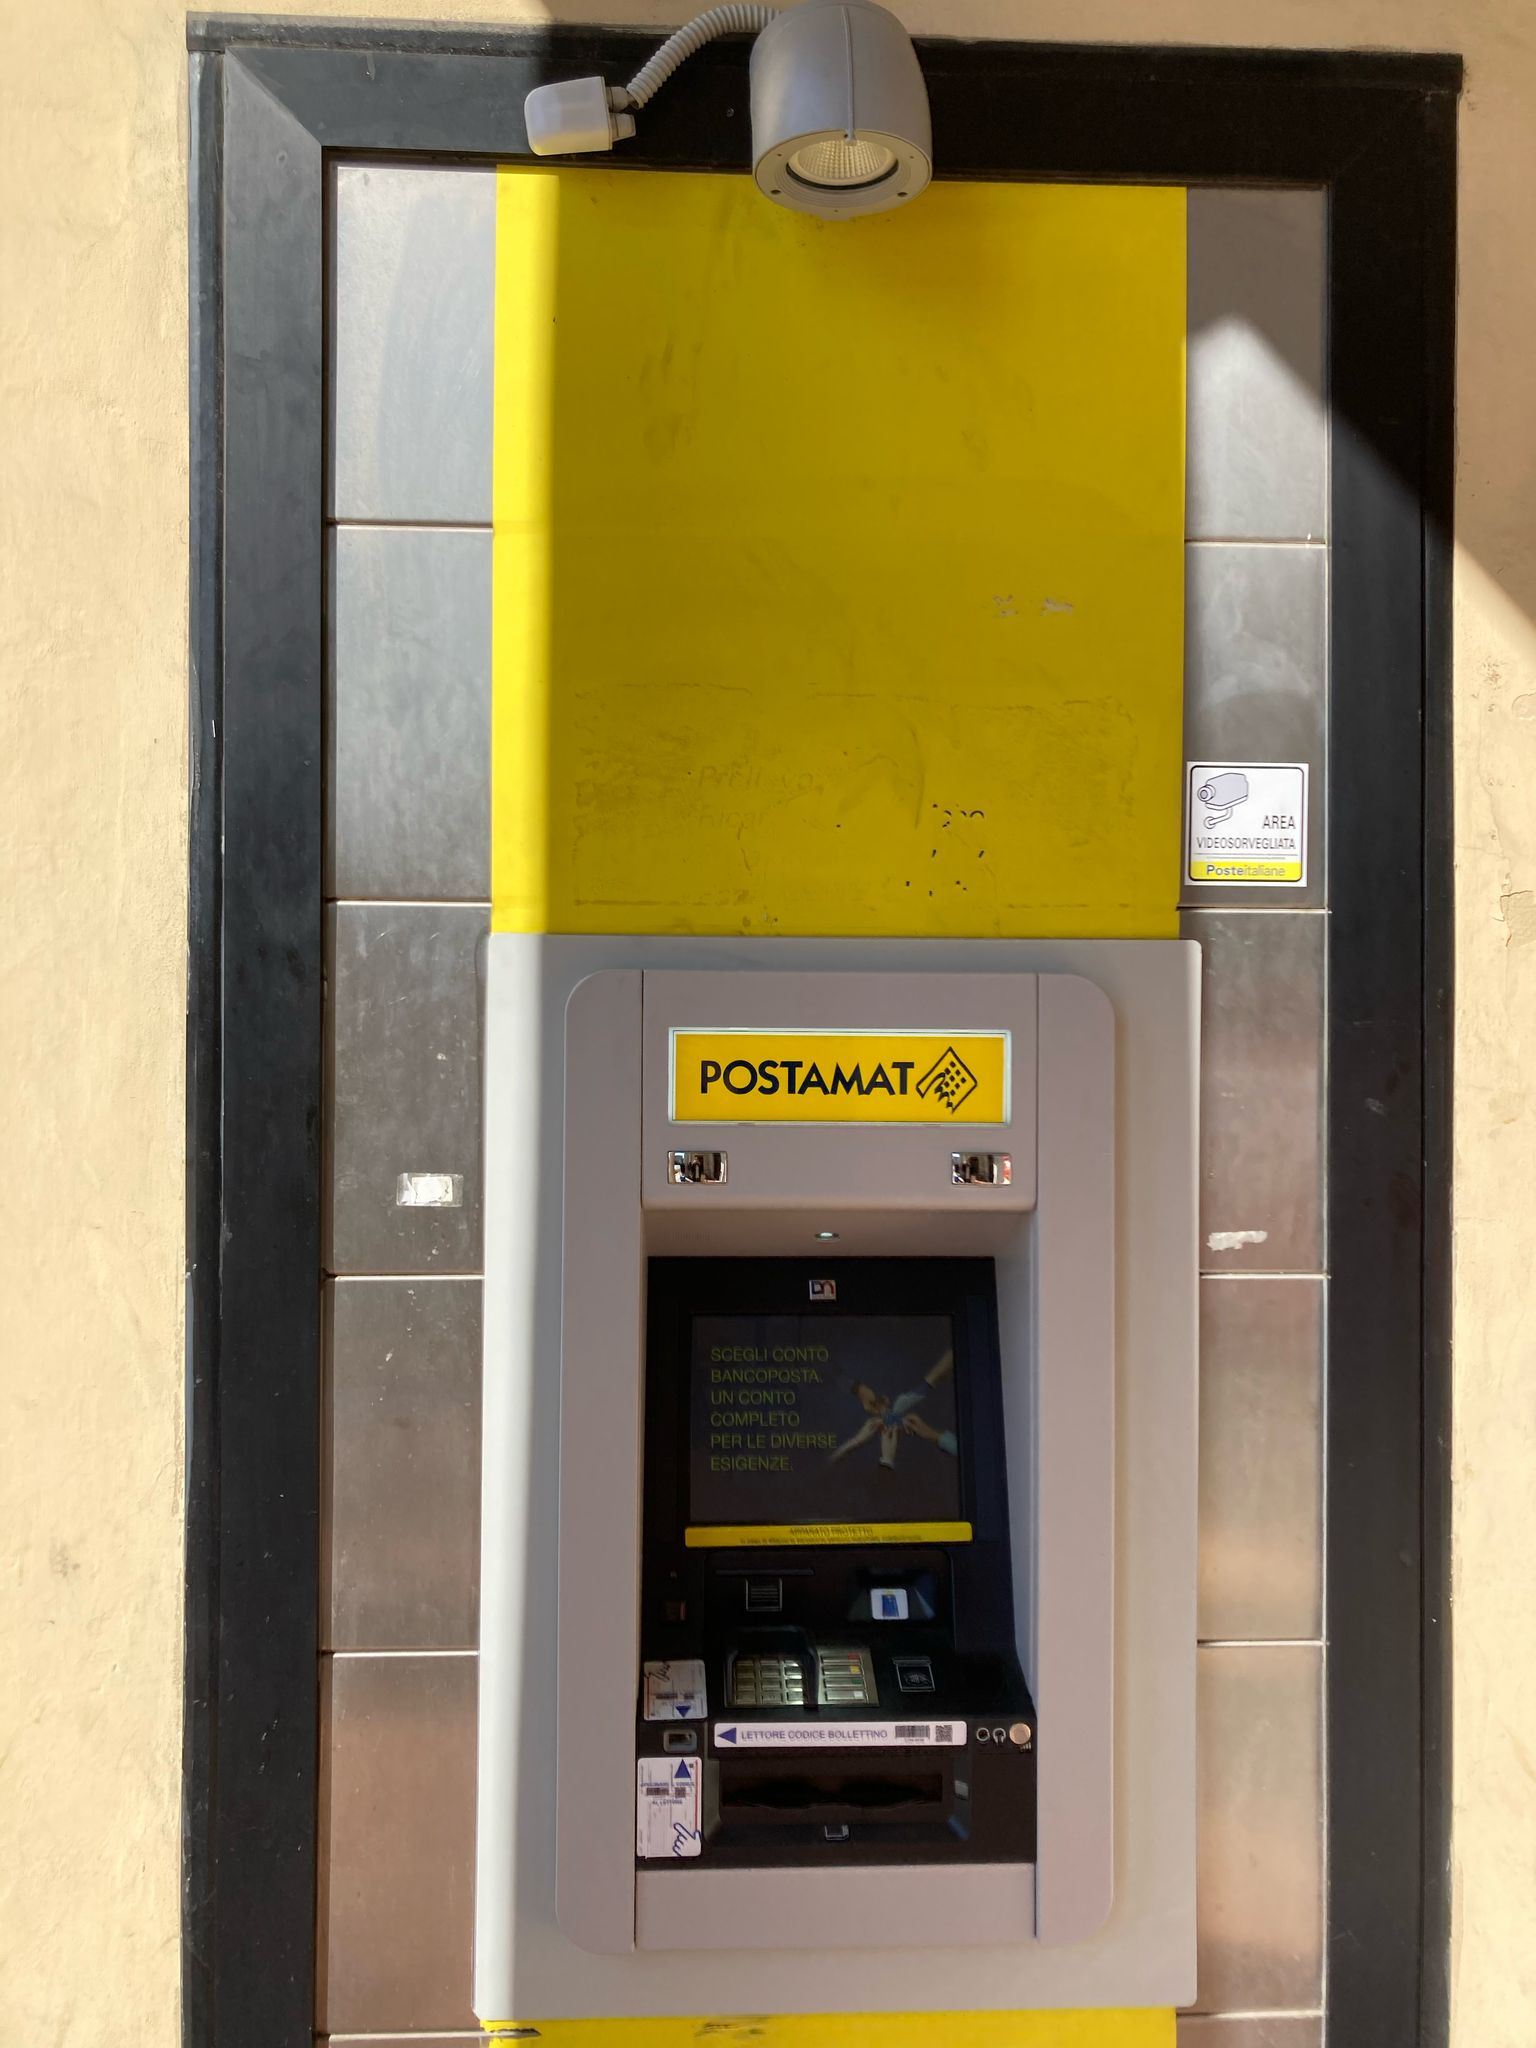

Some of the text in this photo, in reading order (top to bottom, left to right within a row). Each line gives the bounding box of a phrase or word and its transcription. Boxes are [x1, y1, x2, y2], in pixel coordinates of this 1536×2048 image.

[1262, 815, 1296, 829] AREA
[1196, 837, 1296, 849] VIDEOSORVEGLIATA
[700, 1059, 915, 1096] POSTAMAT
[710, 1347, 829, 1362] SCEGLI CONTO
[710, 1369, 823, 1383] BANCOPOSTA.
[710, 1390, 796, 1405] UN CONTO
[710, 1411, 800, 1427] COMPLETO
[710, 1433, 837, 1449] PER LE DIVERSE
[741, 1729, 888, 1740] LETTORE CODICE BOLLETTINO
